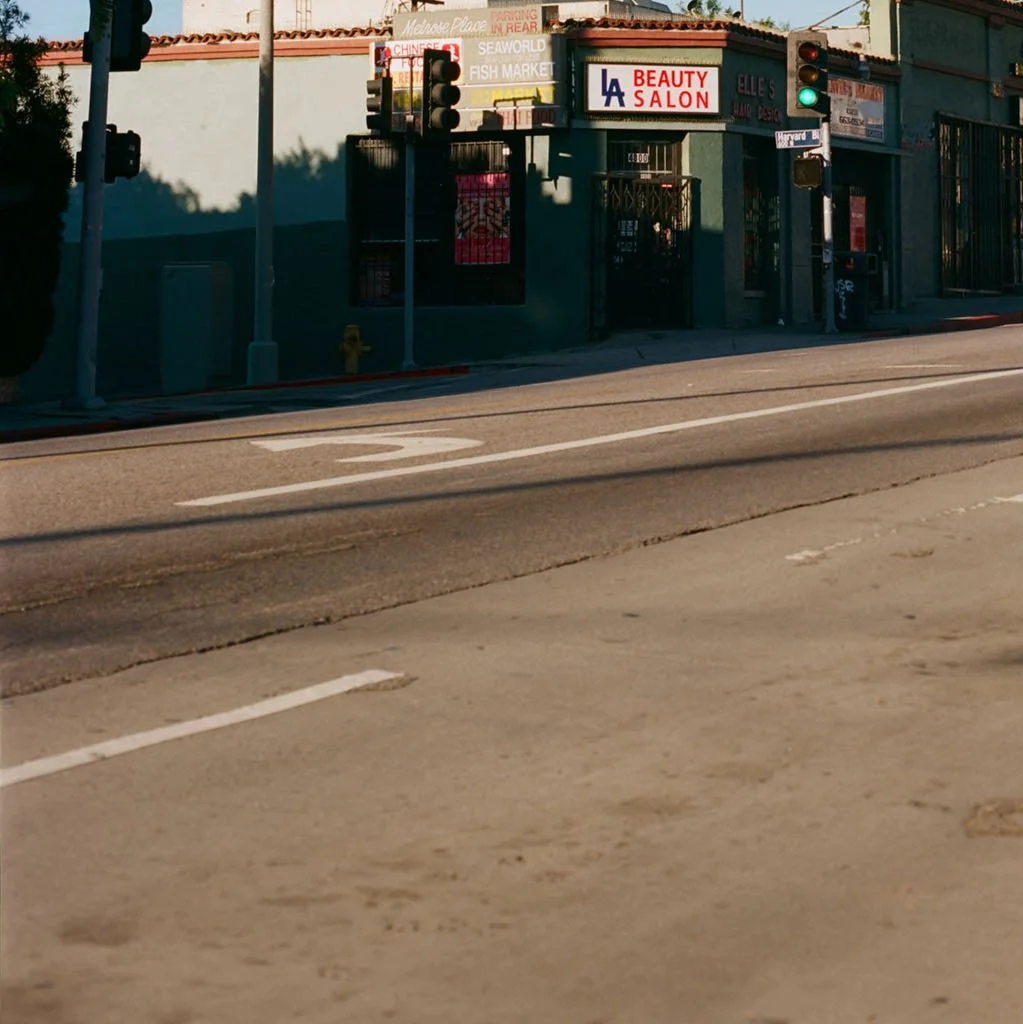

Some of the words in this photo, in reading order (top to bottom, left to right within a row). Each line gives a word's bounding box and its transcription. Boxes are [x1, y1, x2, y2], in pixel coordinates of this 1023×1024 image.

[490, 9, 538, 22] PARKING
[450, 16, 488, 36] Place
[491, 23, 503, 34] IN
[506, 21, 538, 33] REAR
[478, 39, 546, 56] SEAWORLD
[469, 65, 499, 81] FISH
[502, 62, 555, 80] MARKET
[633, 69, 708, 88] BEAUTY
[601, 68, 625, 107] LA
[634, 90, 709, 109] SALON
[777, 131, 806, 143] Harvard
